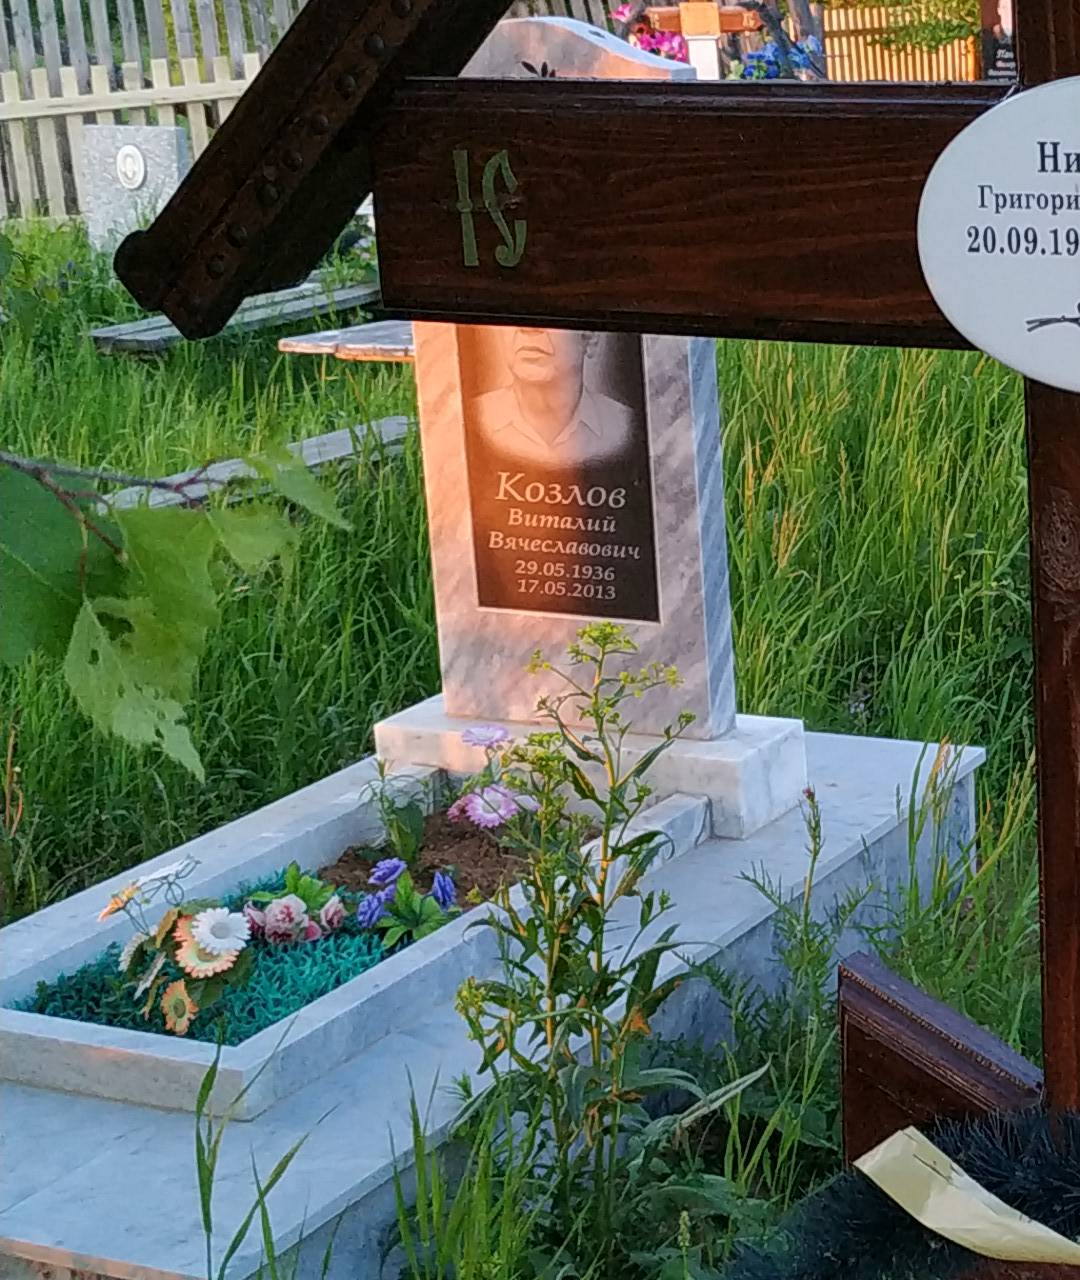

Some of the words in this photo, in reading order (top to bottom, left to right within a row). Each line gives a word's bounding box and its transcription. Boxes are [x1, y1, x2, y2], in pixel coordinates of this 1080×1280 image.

[495, 471, 627, 508] Козлов
[508, 508, 617, 532] Виталий
[488, 531, 641, 560] Вячеславович
[515, 560, 616, 581] 29.05.1936
[517, 579, 617, 600] 17.05.2013
